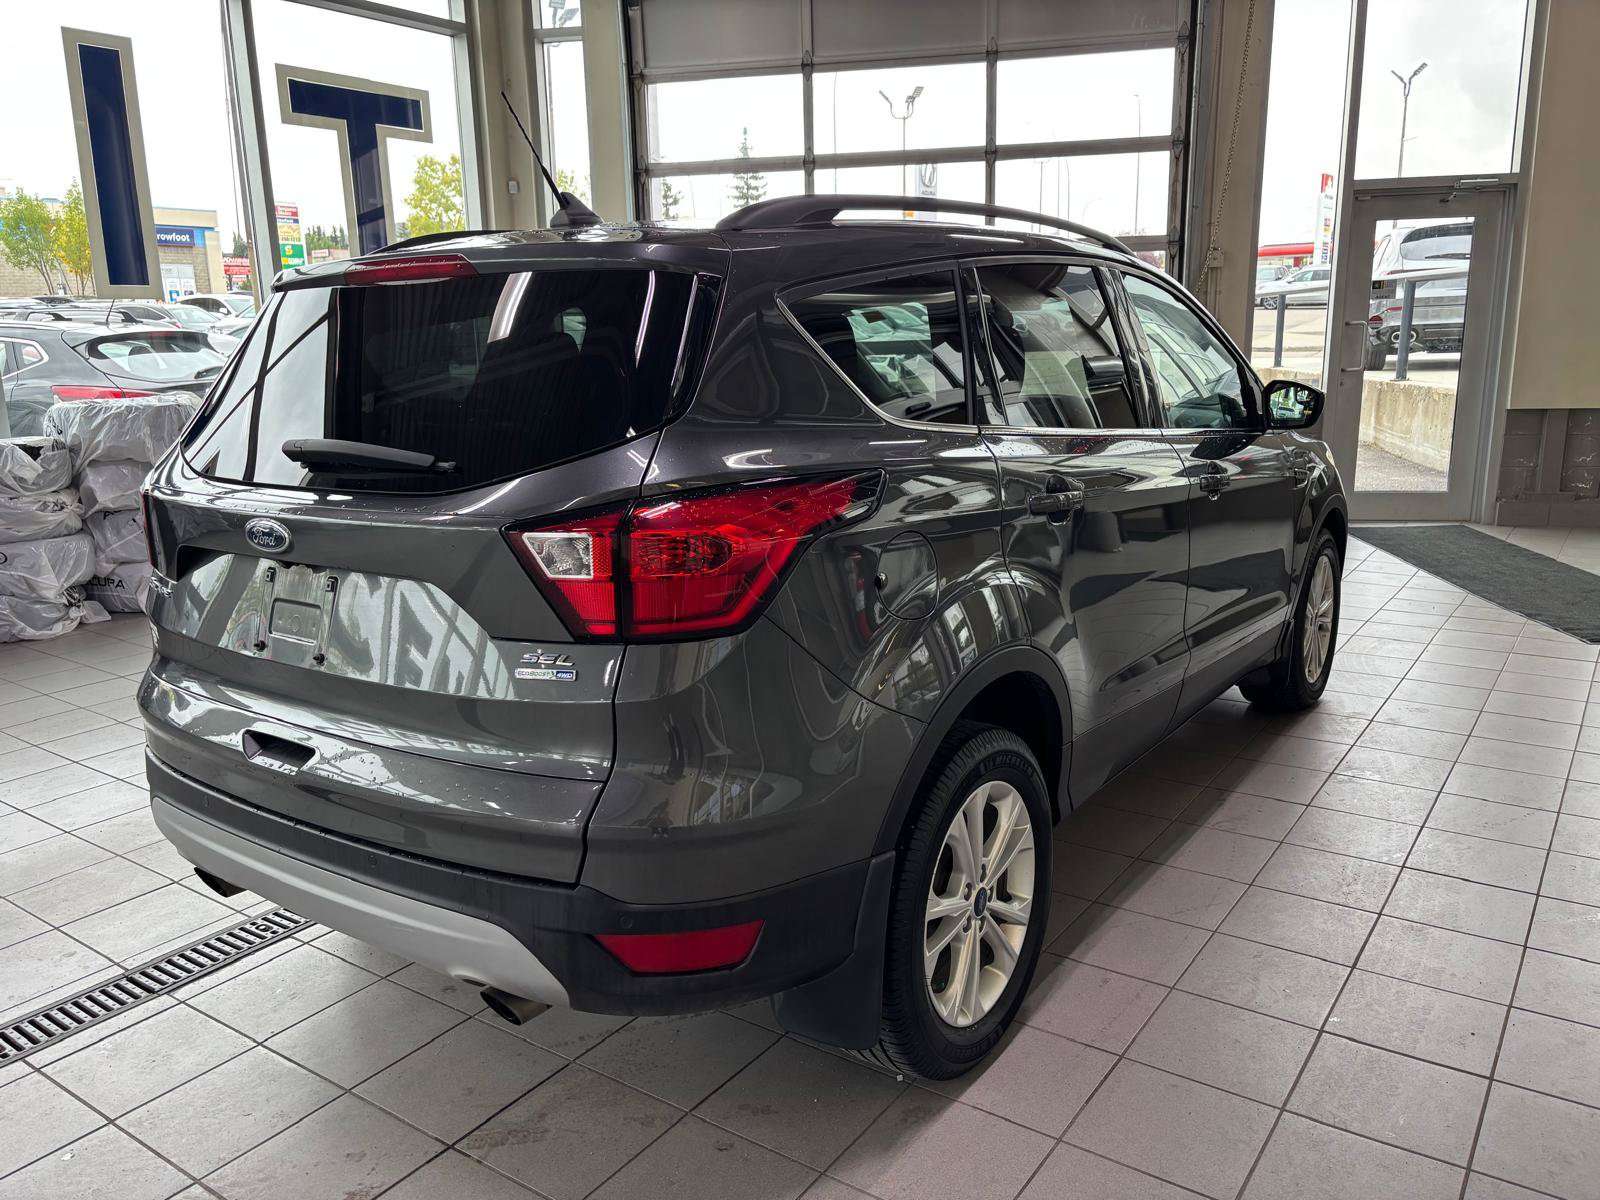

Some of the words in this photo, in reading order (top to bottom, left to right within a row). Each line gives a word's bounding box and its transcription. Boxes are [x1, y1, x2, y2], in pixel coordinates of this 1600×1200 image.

[156, 232, 190, 242] rowfoot
[88, 576, 125, 590] CURA
[520, 653, 575, 666] SEL
[556, 672, 573, 680] 4WD
